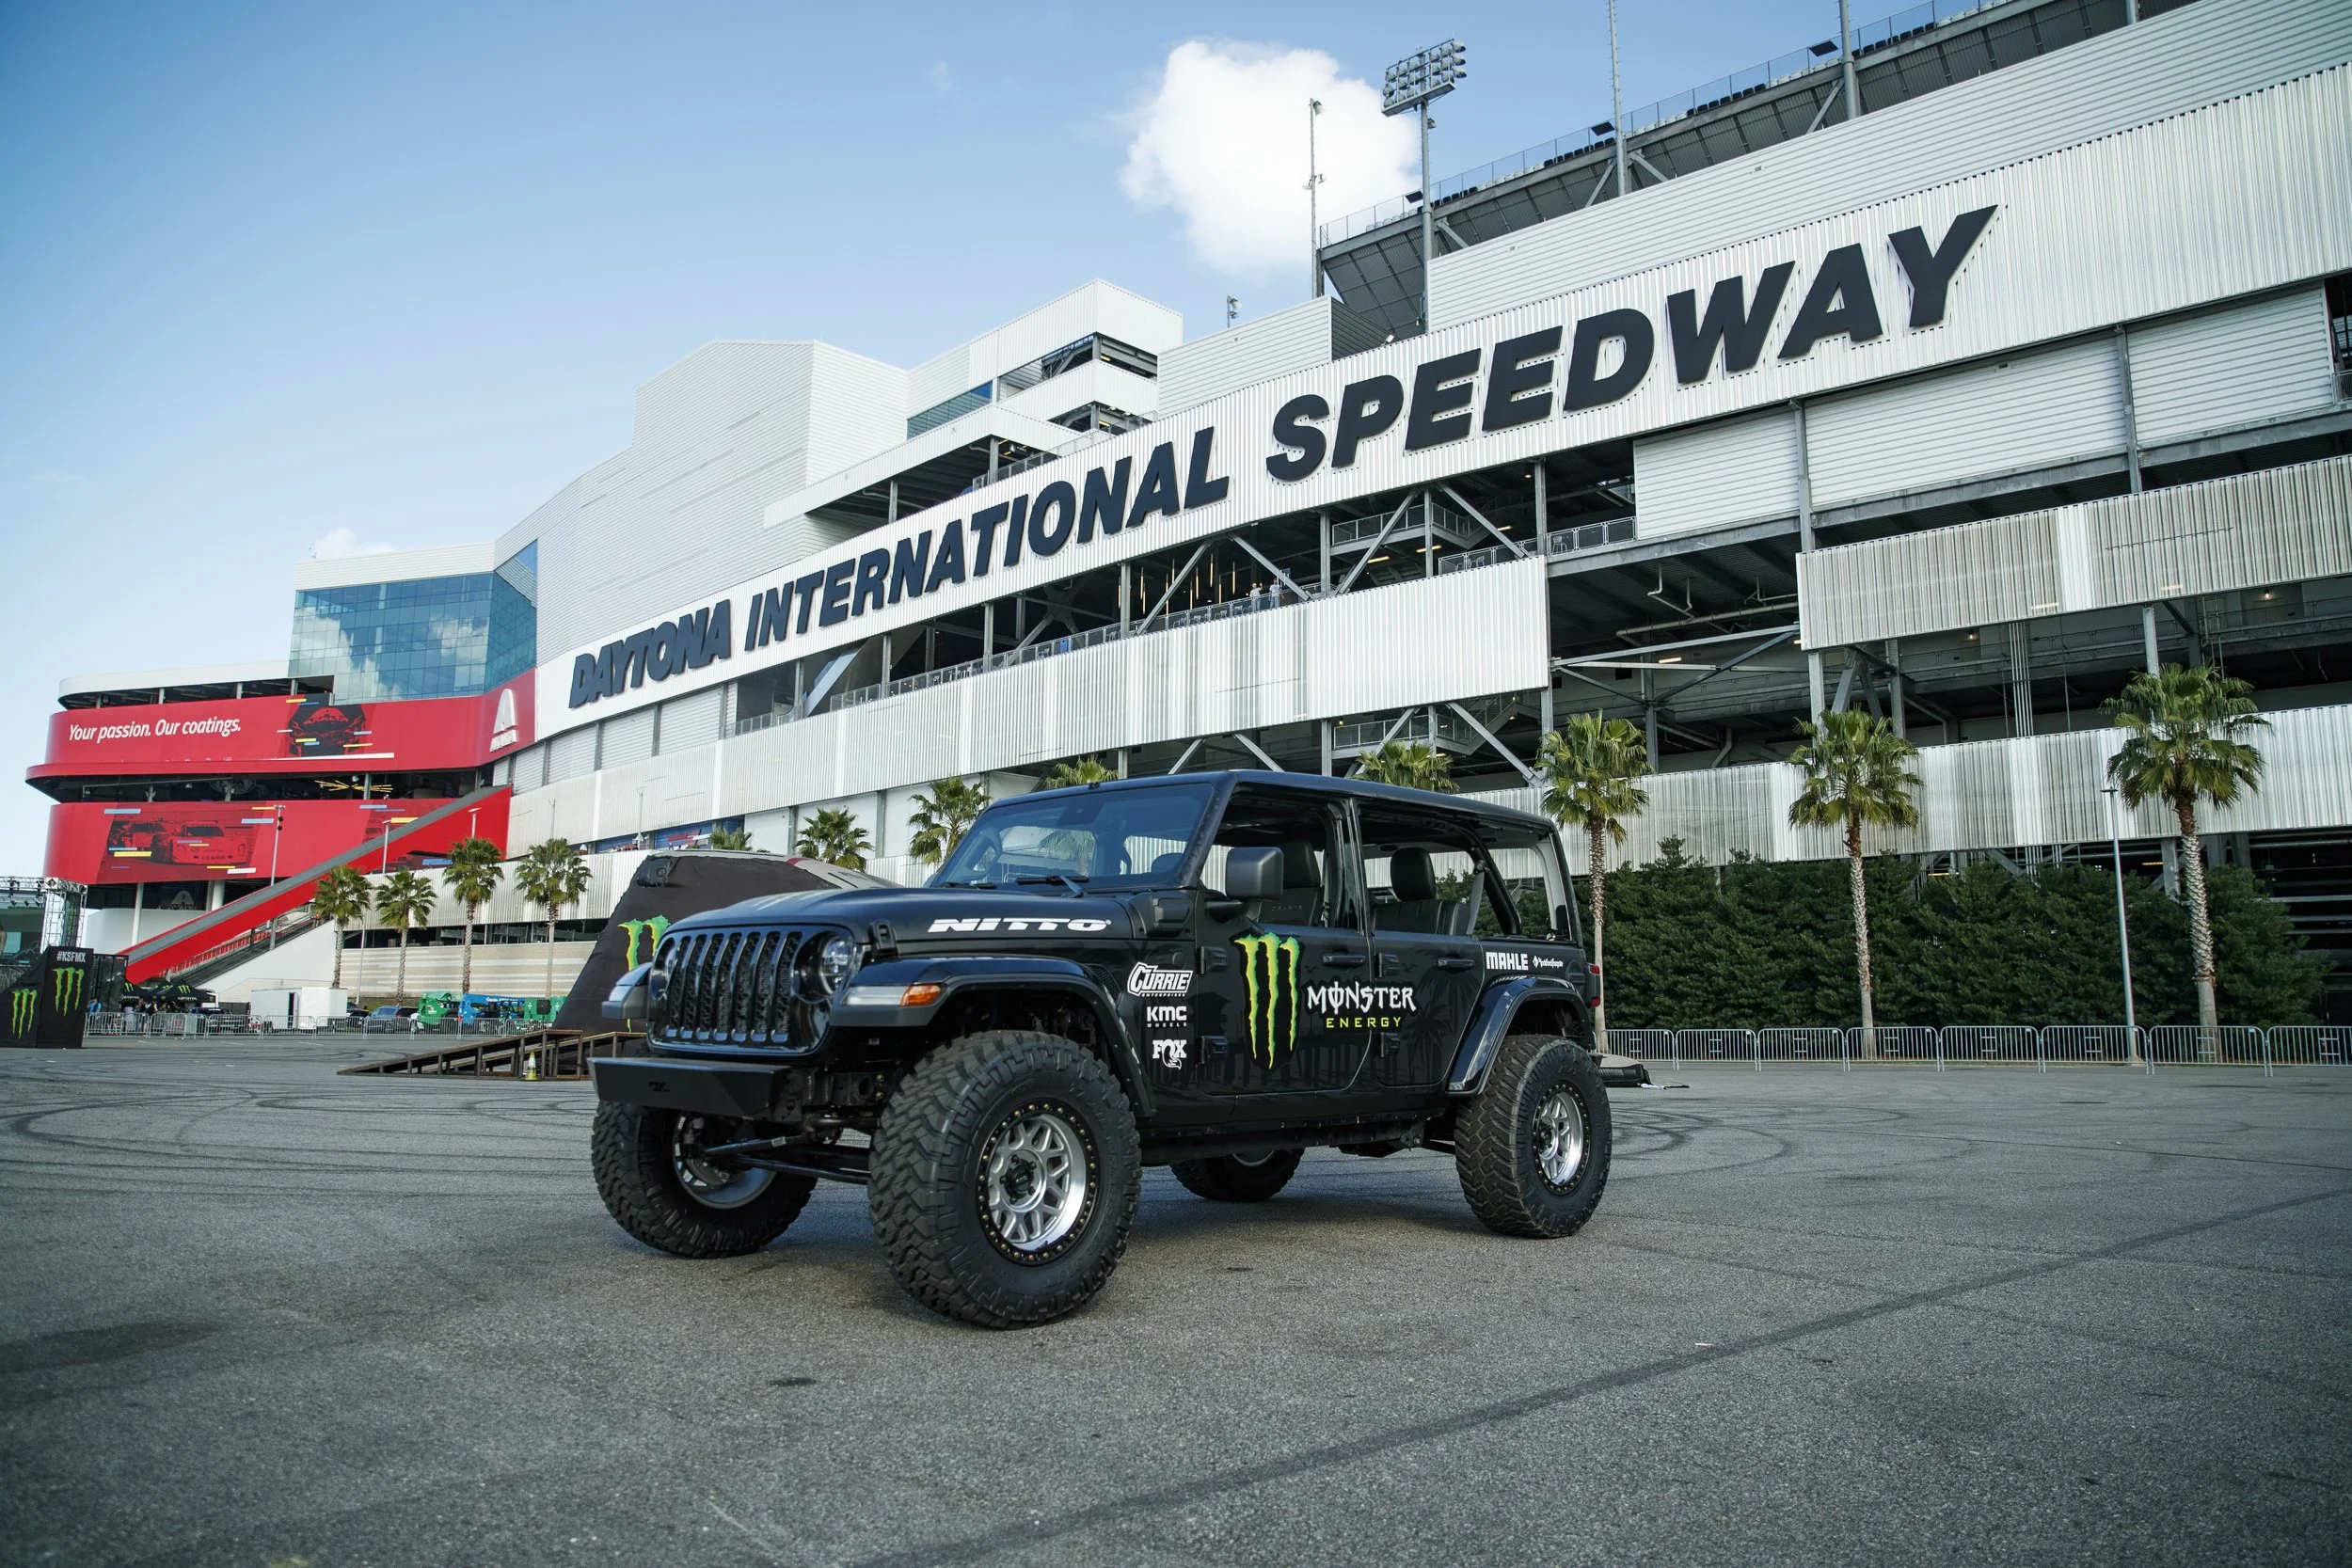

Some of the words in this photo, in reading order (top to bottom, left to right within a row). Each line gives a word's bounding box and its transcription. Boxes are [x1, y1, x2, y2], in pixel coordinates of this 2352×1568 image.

[568, 598, 732, 709] DAYTONA
[743, 425, 1231, 652] INTERNATIONAL
[1265, 204, 1998, 483] SPEEDWAY
[69, 723, 97, 741] Your
[96, 721, 151, 743] passion.
[155, 719, 181, 736] Our
[182, 716, 242, 737] coatings.
[928, 917, 1107, 933] NITTO
[56, 951, 87, 963] #KSFMX
[1486, 951, 1529, 971] MAHLE
[1129, 963, 1192, 993] CURRIE
[1307, 980, 1417, 1015] MONSTER
[1147, 1006, 1187, 1022] KMC
[1326, 1017, 1401, 1029] ENERGY
[1152, 1038, 1187, 1069] FOX
